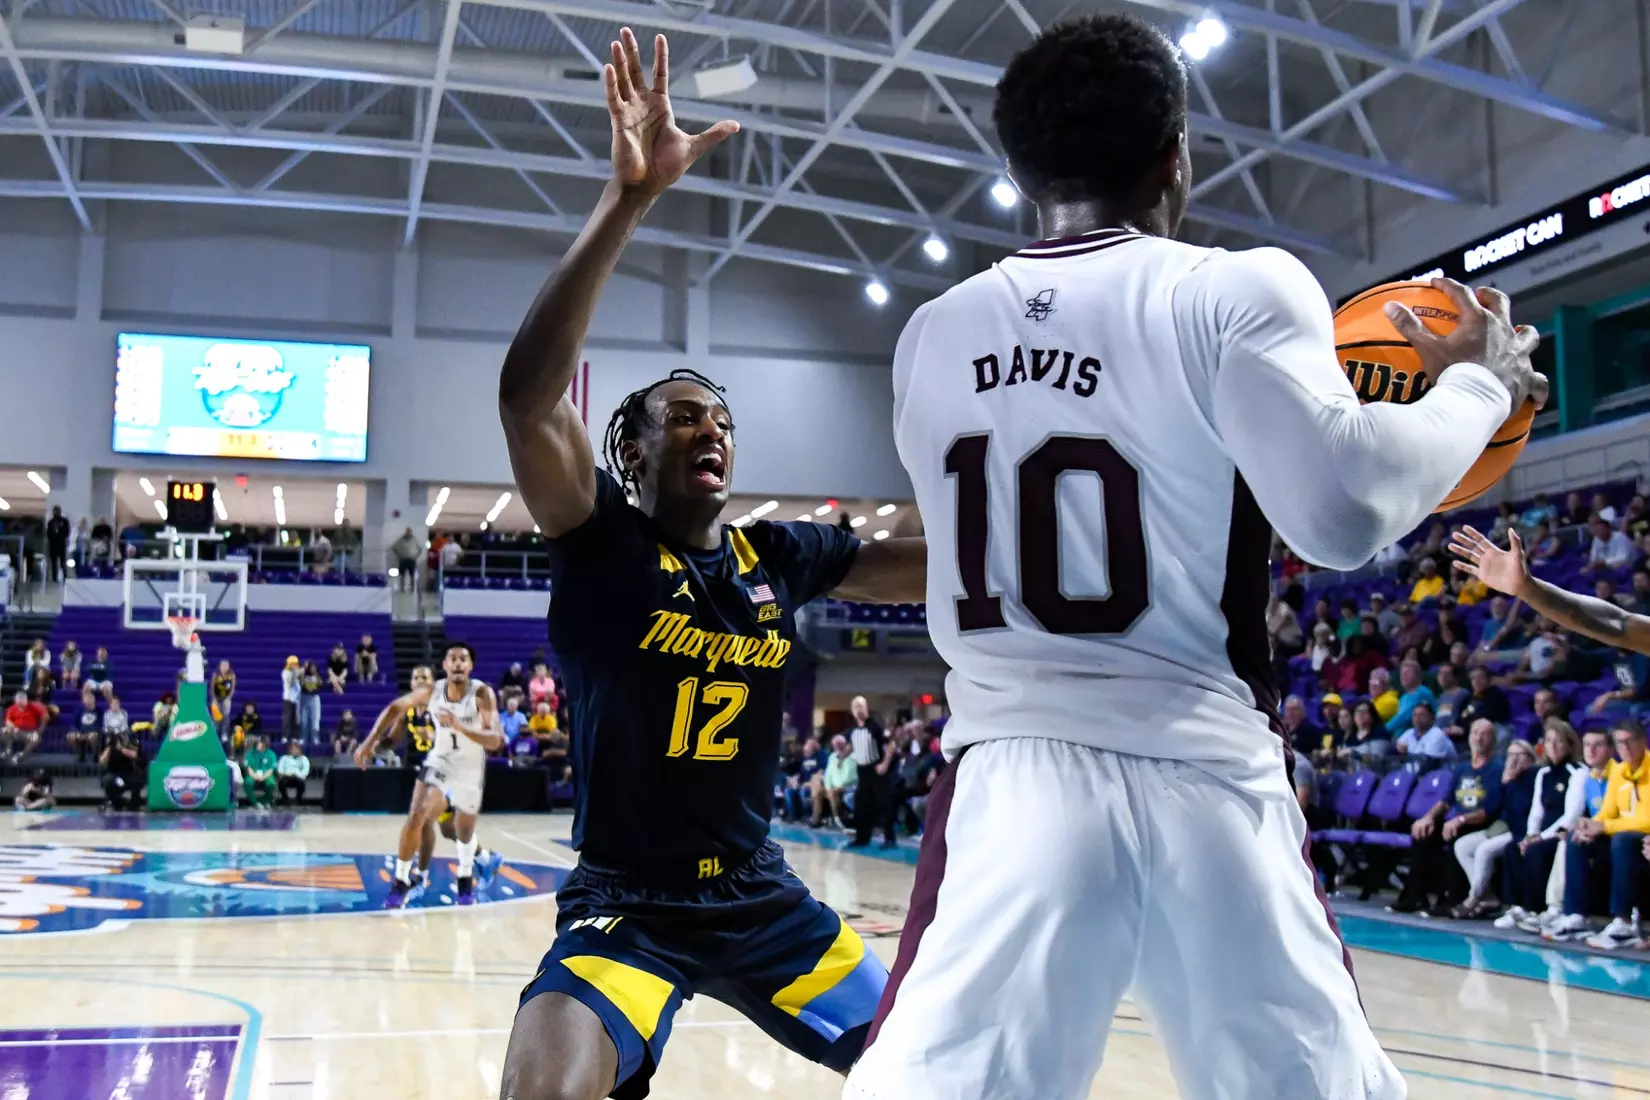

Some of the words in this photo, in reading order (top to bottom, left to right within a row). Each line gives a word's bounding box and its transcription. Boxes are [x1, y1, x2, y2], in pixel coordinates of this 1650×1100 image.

[972, 345, 1101, 398] DAVIS
[1345, 359, 1432, 405] Wil
[943, 429, 1154, 638] 10
[758, 609, 782, 620] EAST
[760, 603, 777, 612] BIG
[639, 610, 791, 673] Marquette
[451, 732, 460, 749] 1
[666, 676, 749, 760] 12
[698, 855, 725, 880] AL
